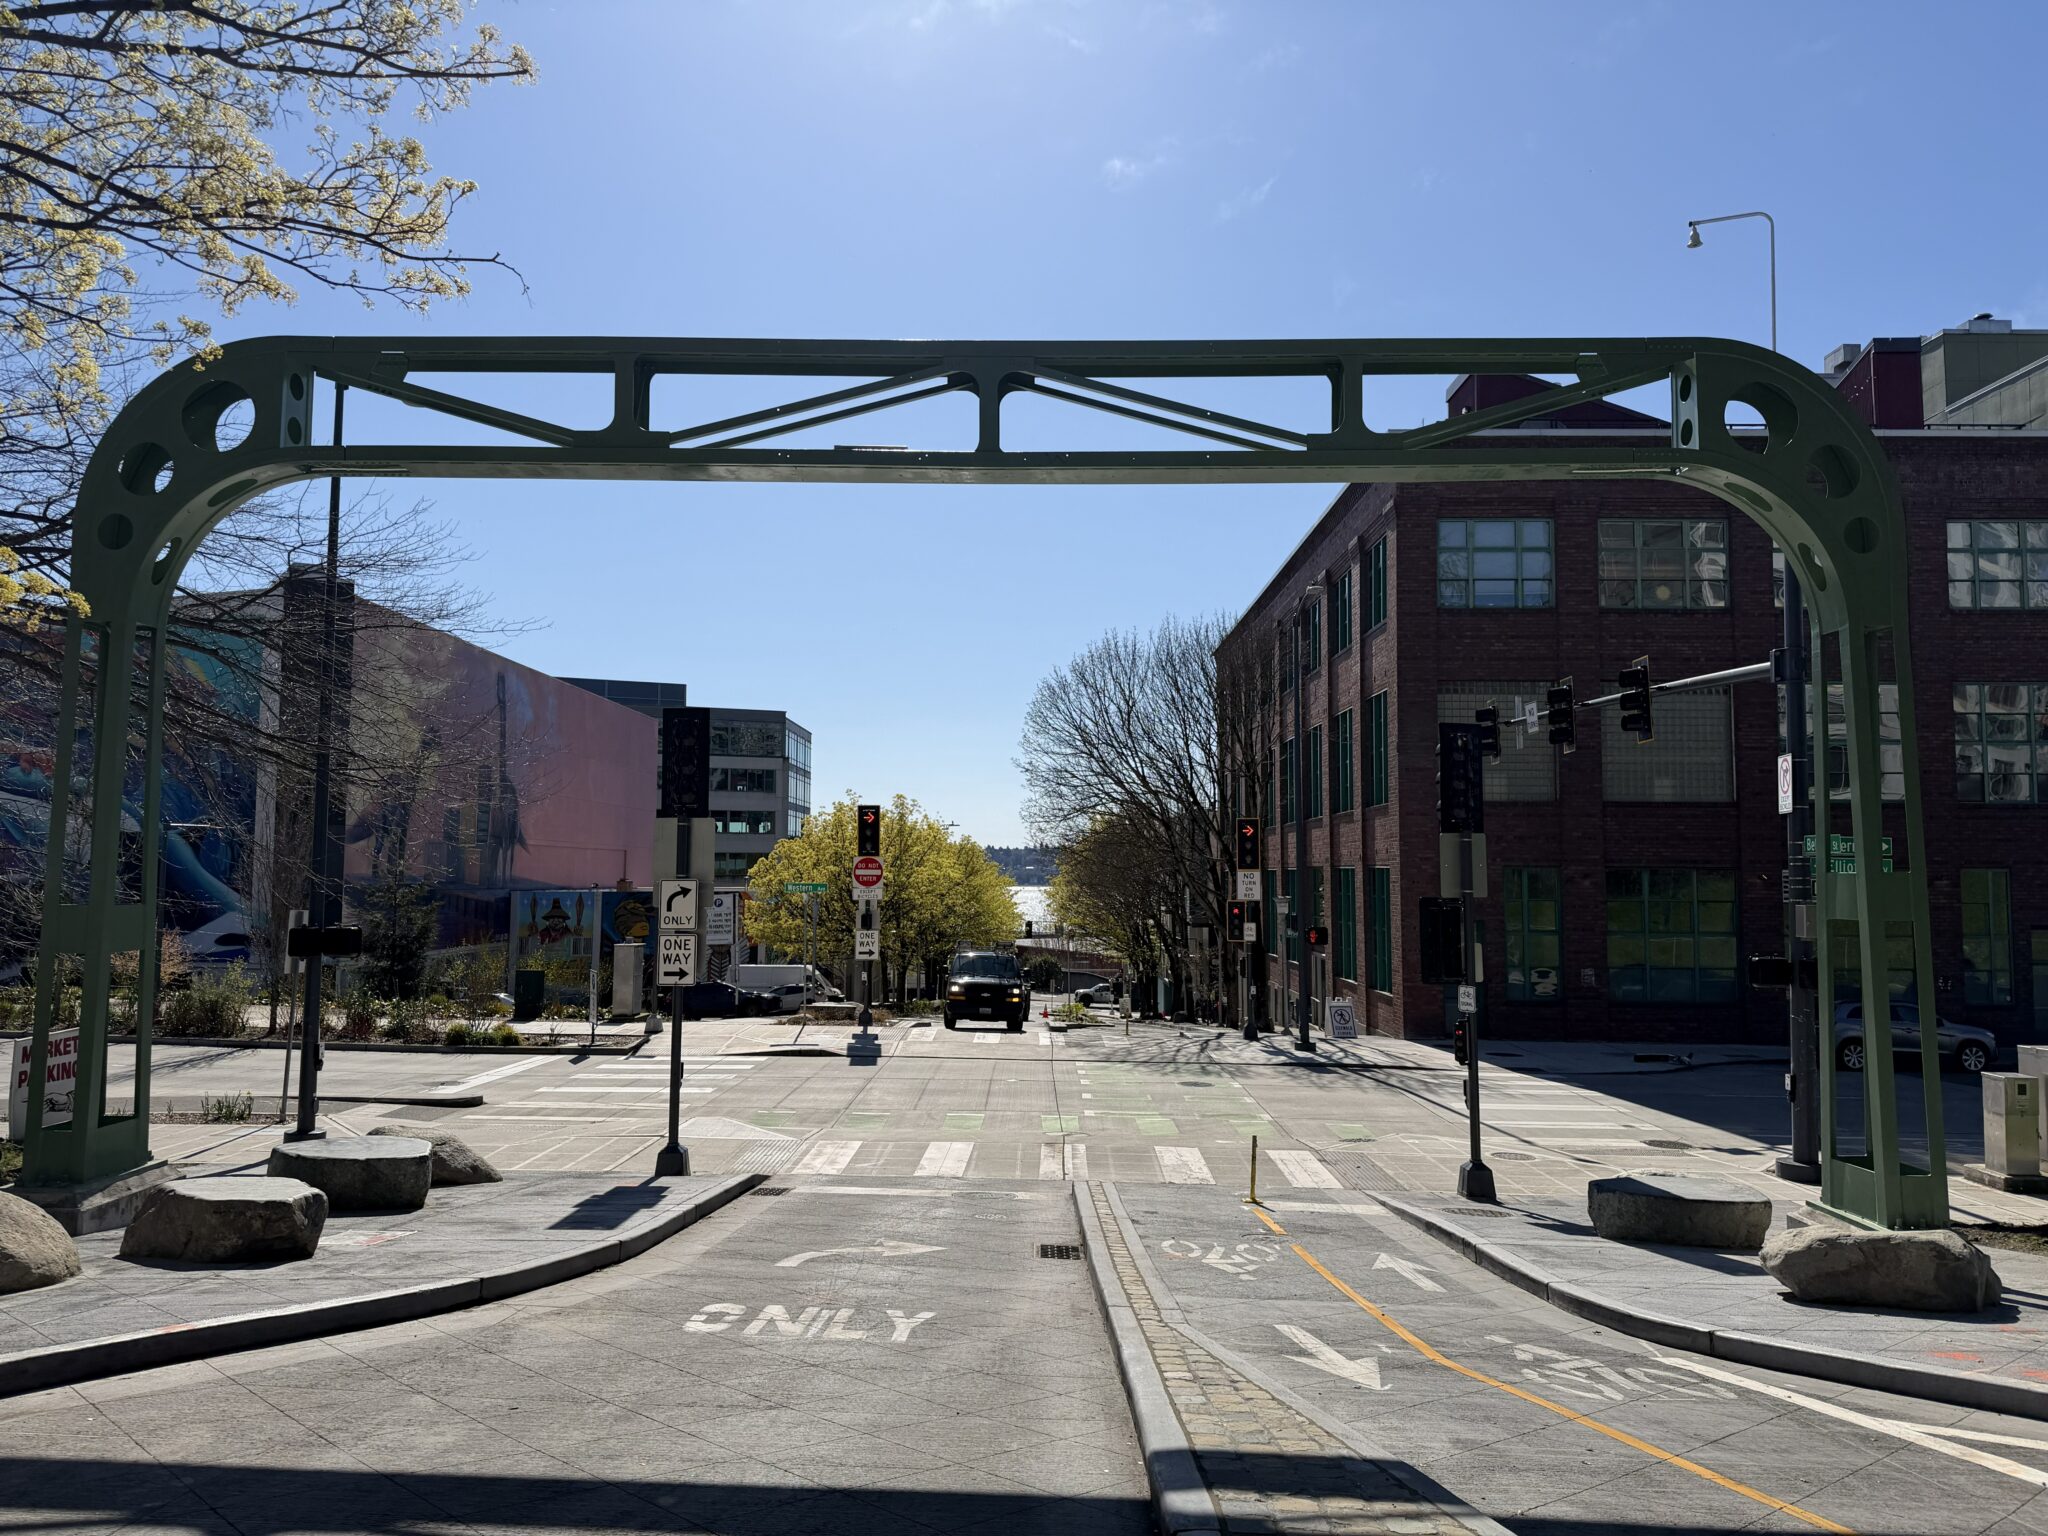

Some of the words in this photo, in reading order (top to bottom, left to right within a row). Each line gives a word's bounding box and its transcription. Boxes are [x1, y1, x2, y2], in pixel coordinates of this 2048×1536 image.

[787, 884, 813, 892] Western
[663, 916, 693, 925] ONLY
[664, 939, 691, 951] ONE
[858, 940, 876, 948] WAY
[662, 953, 691, 965] WAY
[21, 1036, 80, 1064] MRKET
[682, 1302, 938, 1343] ONLY
